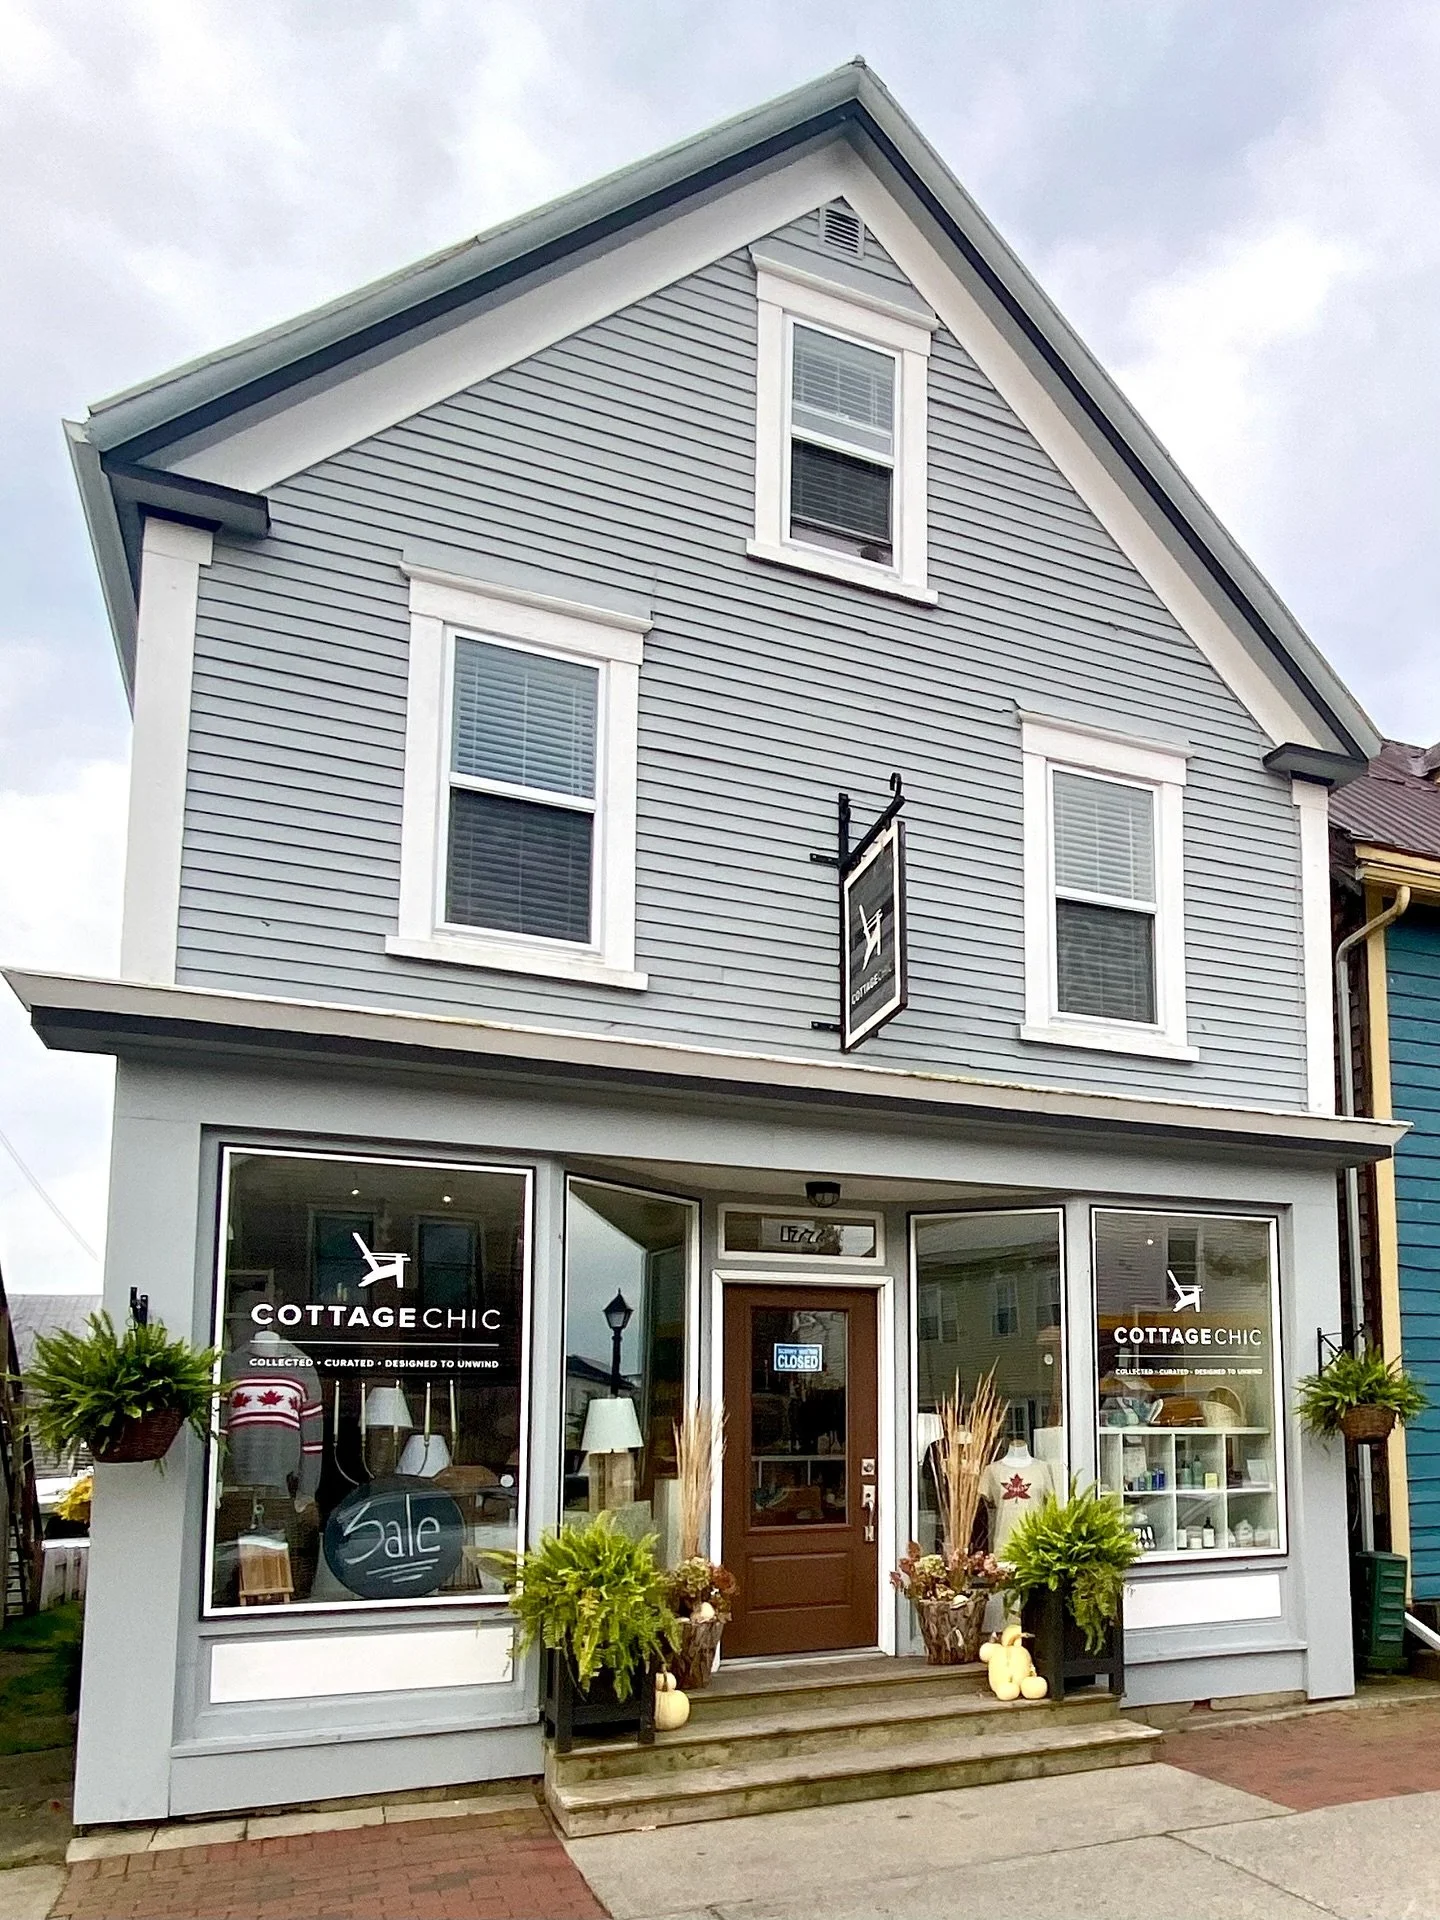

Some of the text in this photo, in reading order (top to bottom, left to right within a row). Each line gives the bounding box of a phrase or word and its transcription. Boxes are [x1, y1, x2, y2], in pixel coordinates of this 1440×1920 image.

[249, 1357, 499, 1369] COLLECTED CURATED DESIGNED TO UNWIND
[778, 1355, 819, 1369] CLOSED
[343, 1493, 440, 1565] Sale
